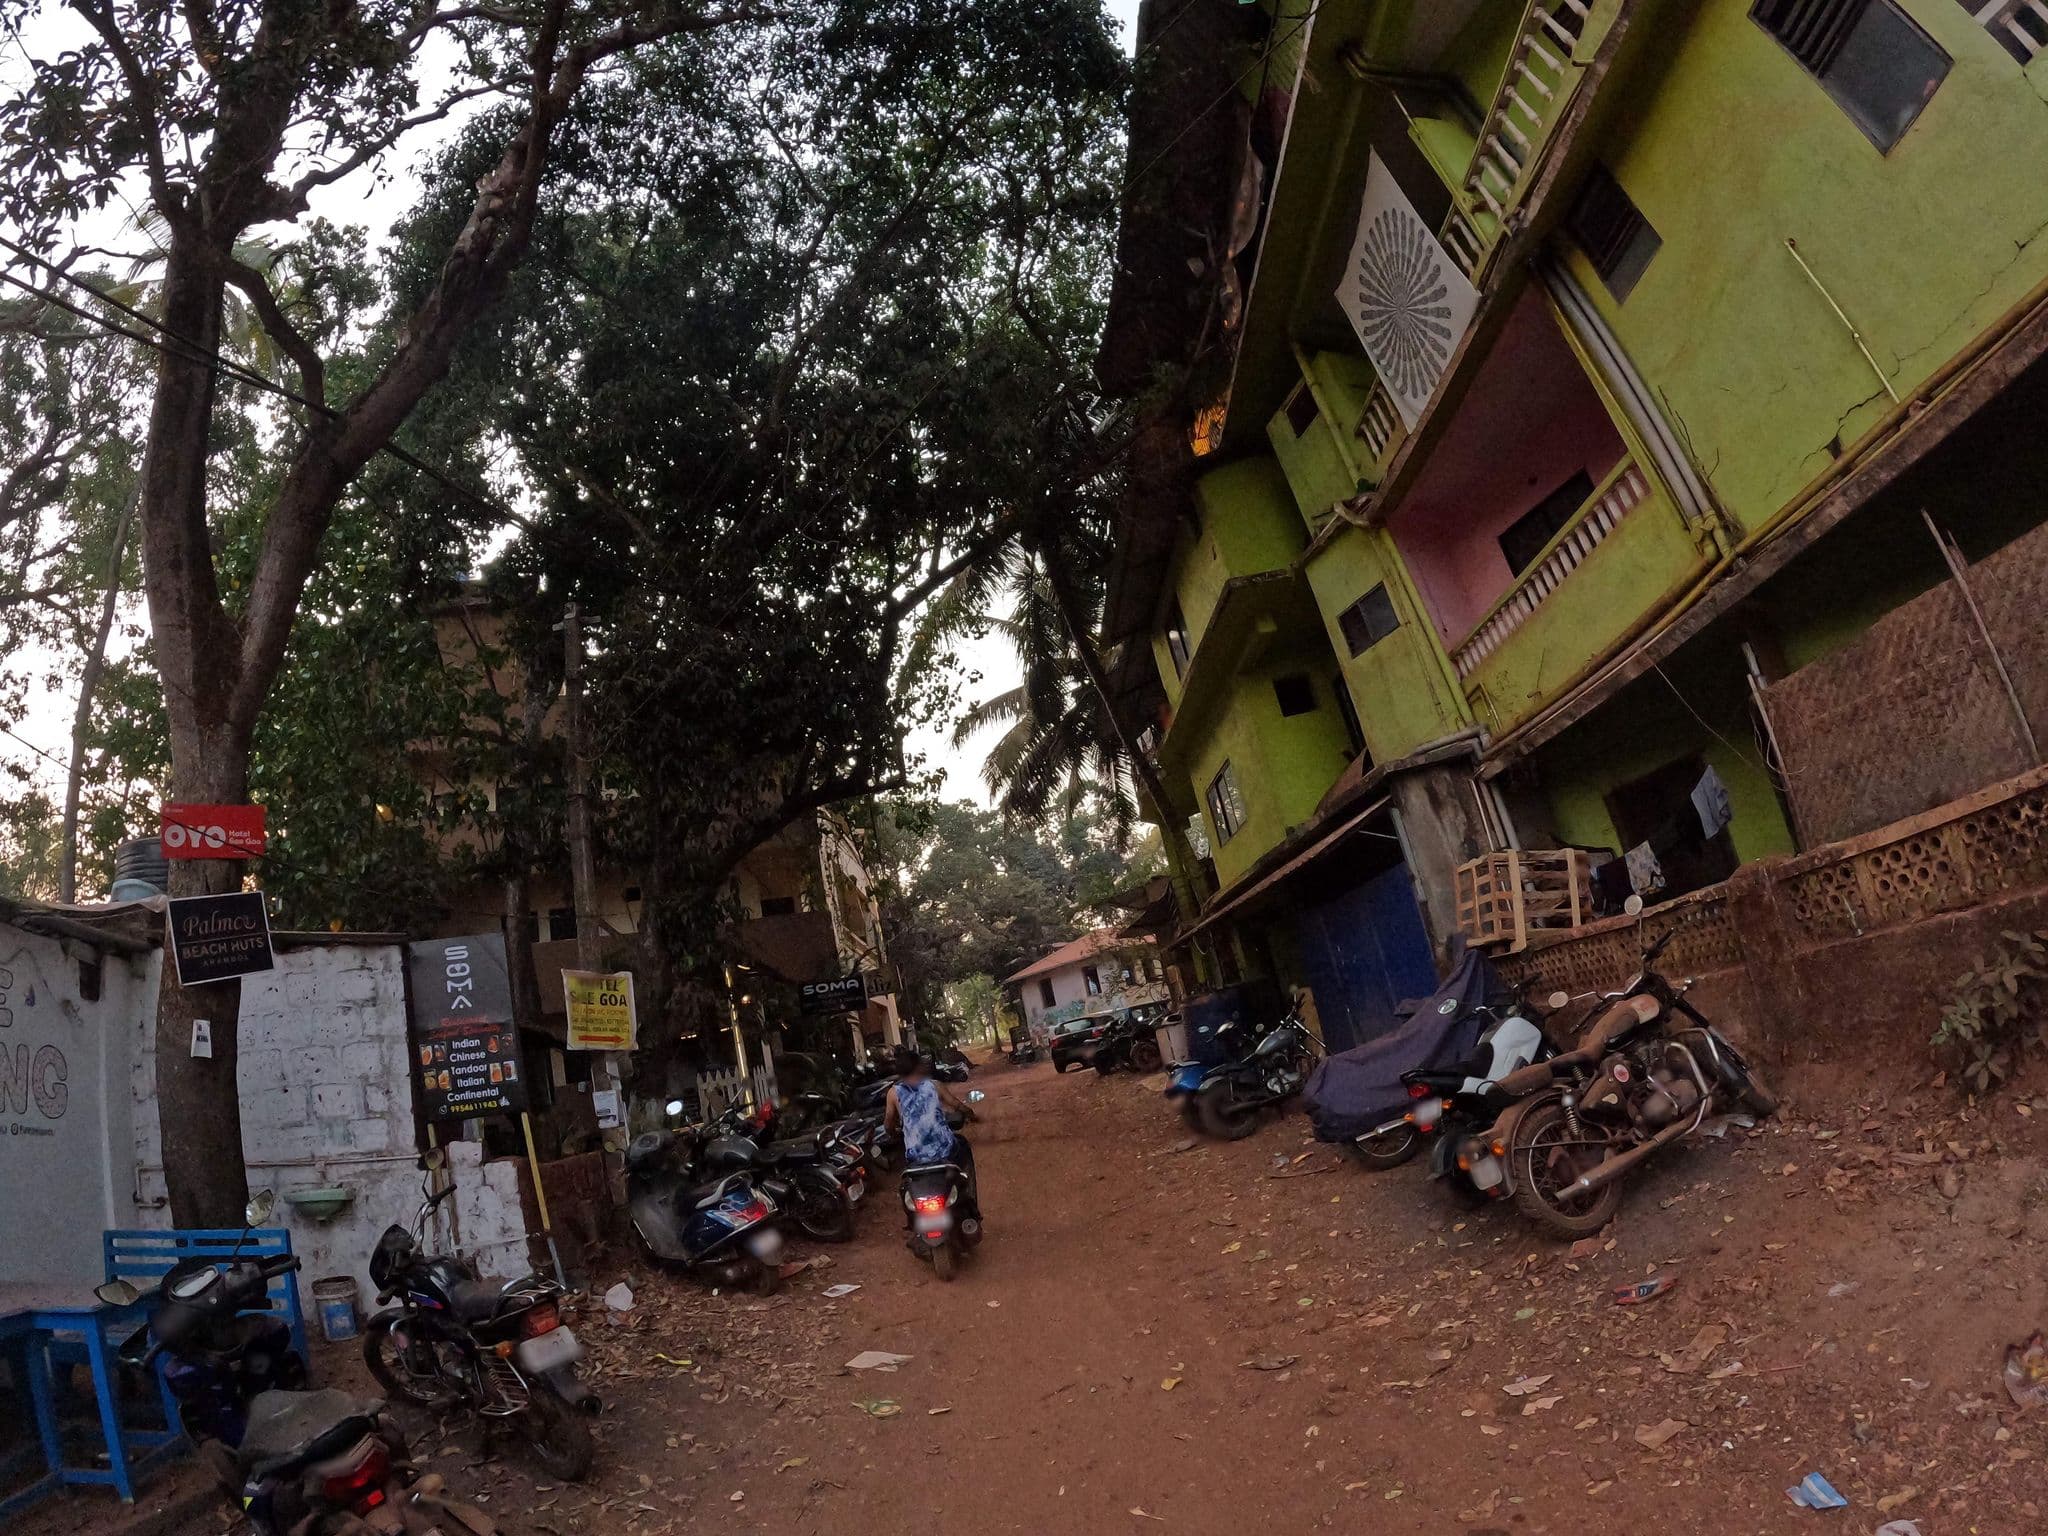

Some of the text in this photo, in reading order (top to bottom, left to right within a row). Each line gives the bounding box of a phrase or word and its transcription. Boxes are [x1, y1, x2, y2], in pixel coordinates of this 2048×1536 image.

[164, 825, 226, 848] OYO
[182, 936, 264, 959] BEACH HUTS
[444, 945, 473, 1010] SOMA
[803, 979, 859, 995] SOMA
[600, 992, 627, 1007] GOA
[452, 1038, 481, 1049] Indian
[449, 1050, 486, 1062] Chinese
[457, 1077, 486, 1088] Italian
[447, 1087, 500, 1102] Continental
